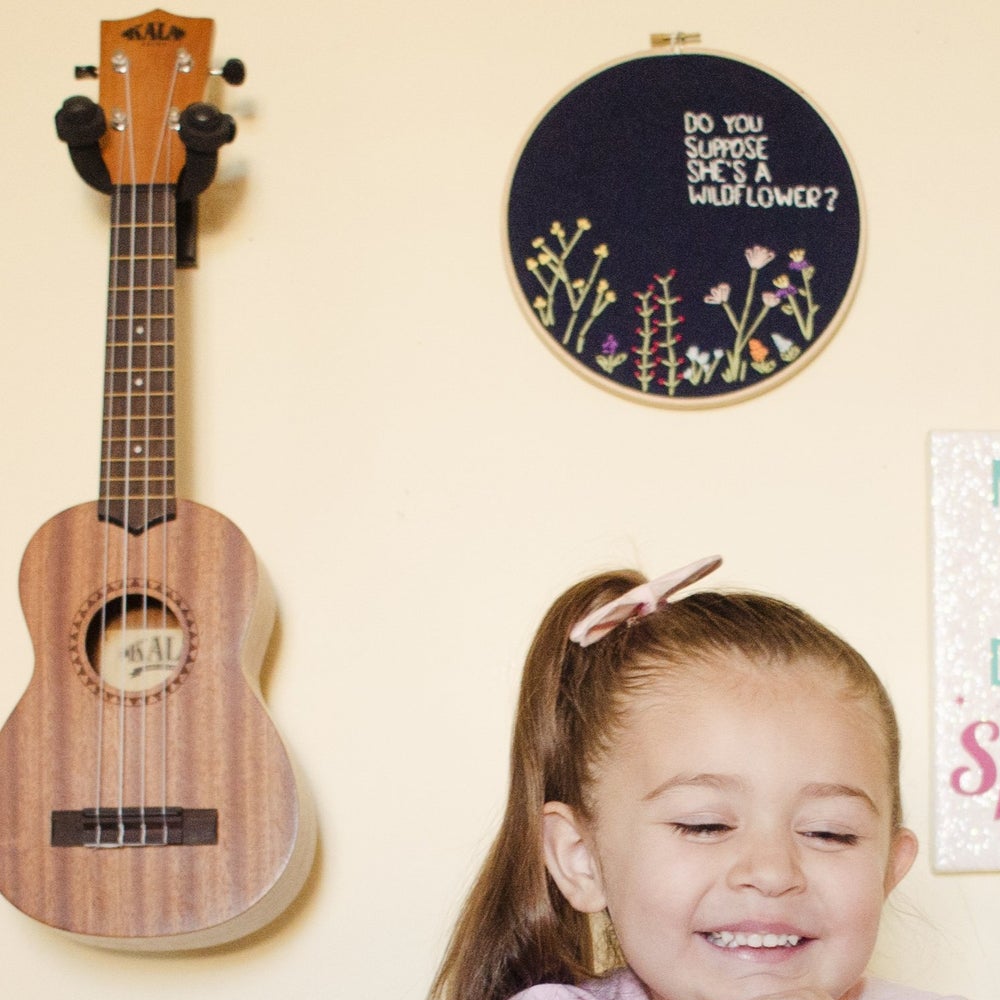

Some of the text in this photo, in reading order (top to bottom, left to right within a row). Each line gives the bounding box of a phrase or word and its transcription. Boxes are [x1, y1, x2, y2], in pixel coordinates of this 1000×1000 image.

[683, 111, 764, 134] DO YOU
[684, 136, 768, 160] SUPPOSE
[686, 160, 772, 183] SHE'S A
[688, 184, 839, 212] WILDFLOWER?
[124, 636, 180, 662] KAL
